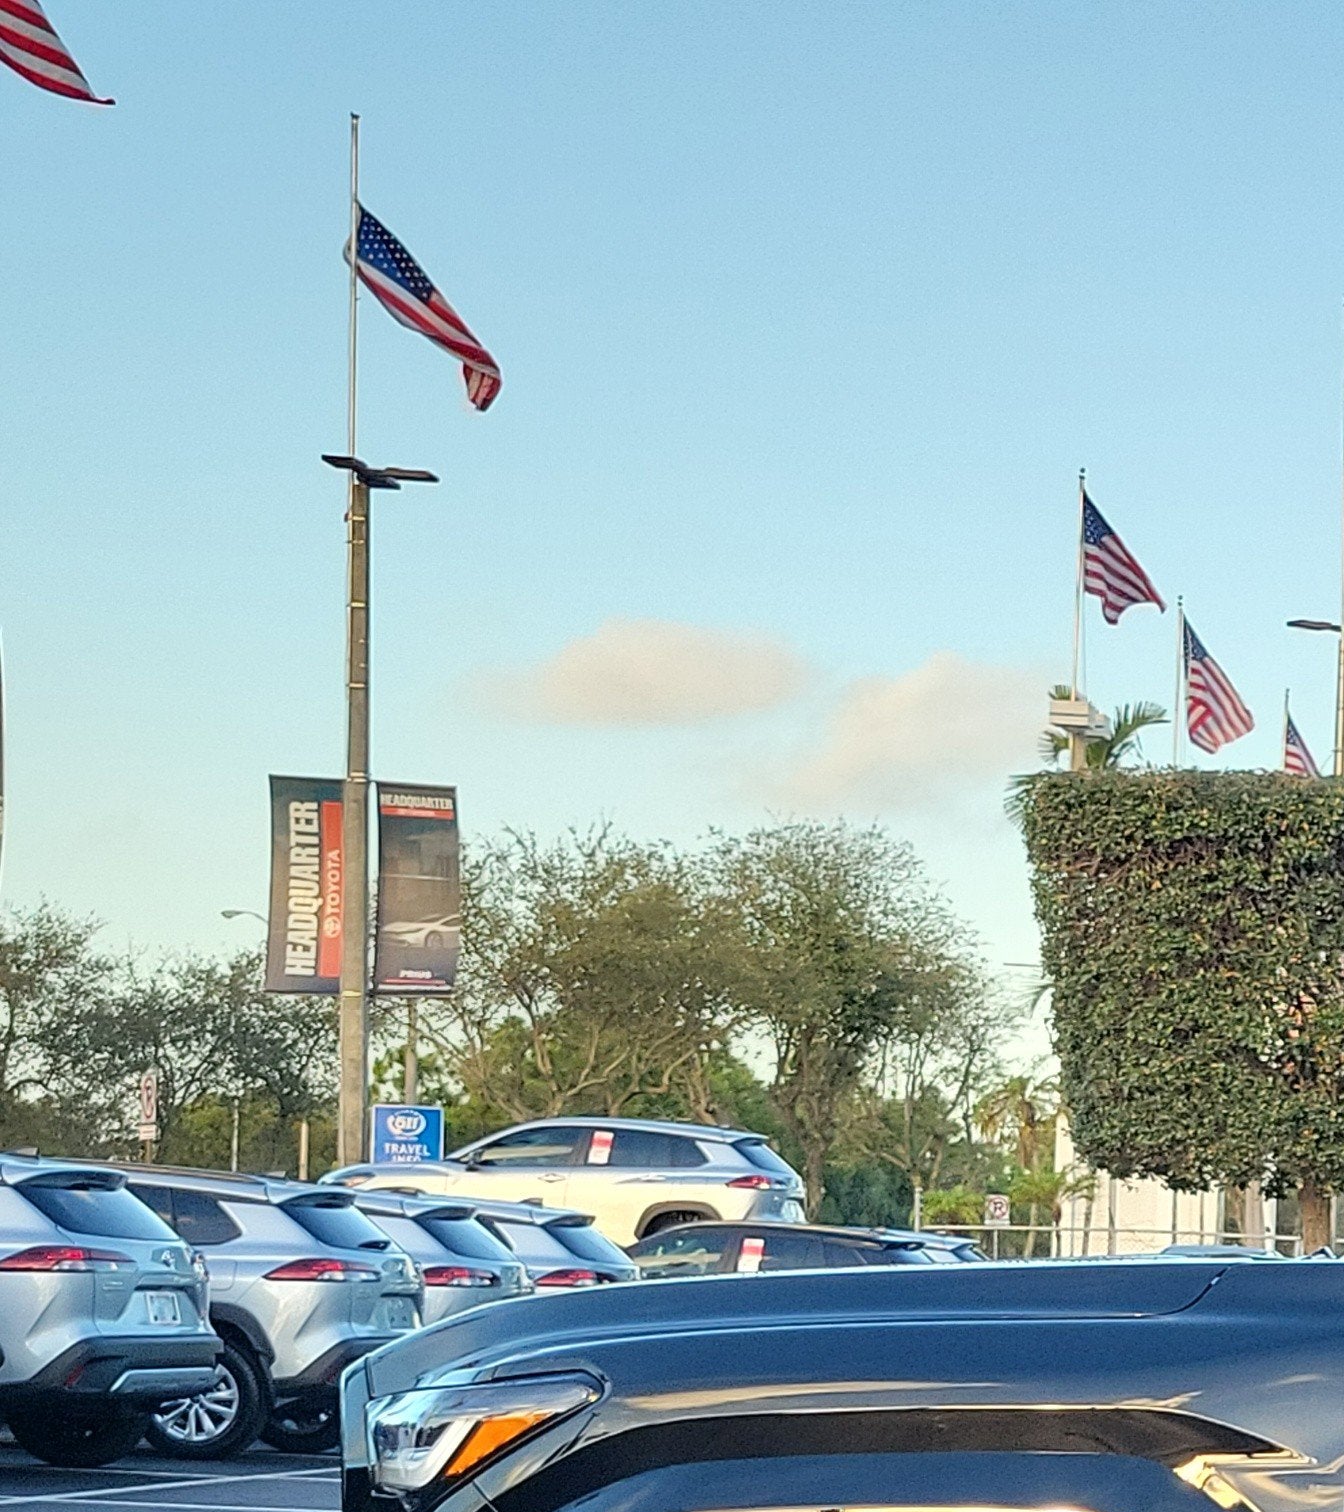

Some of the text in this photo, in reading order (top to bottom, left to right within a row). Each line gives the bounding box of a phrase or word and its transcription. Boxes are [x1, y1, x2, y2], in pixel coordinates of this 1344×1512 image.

[284, 800, 323, 976] HEADQUARTER
[326, 849, 341, 914] TOYOTA
[384, 1142, 431, 1157] TRAVEL
